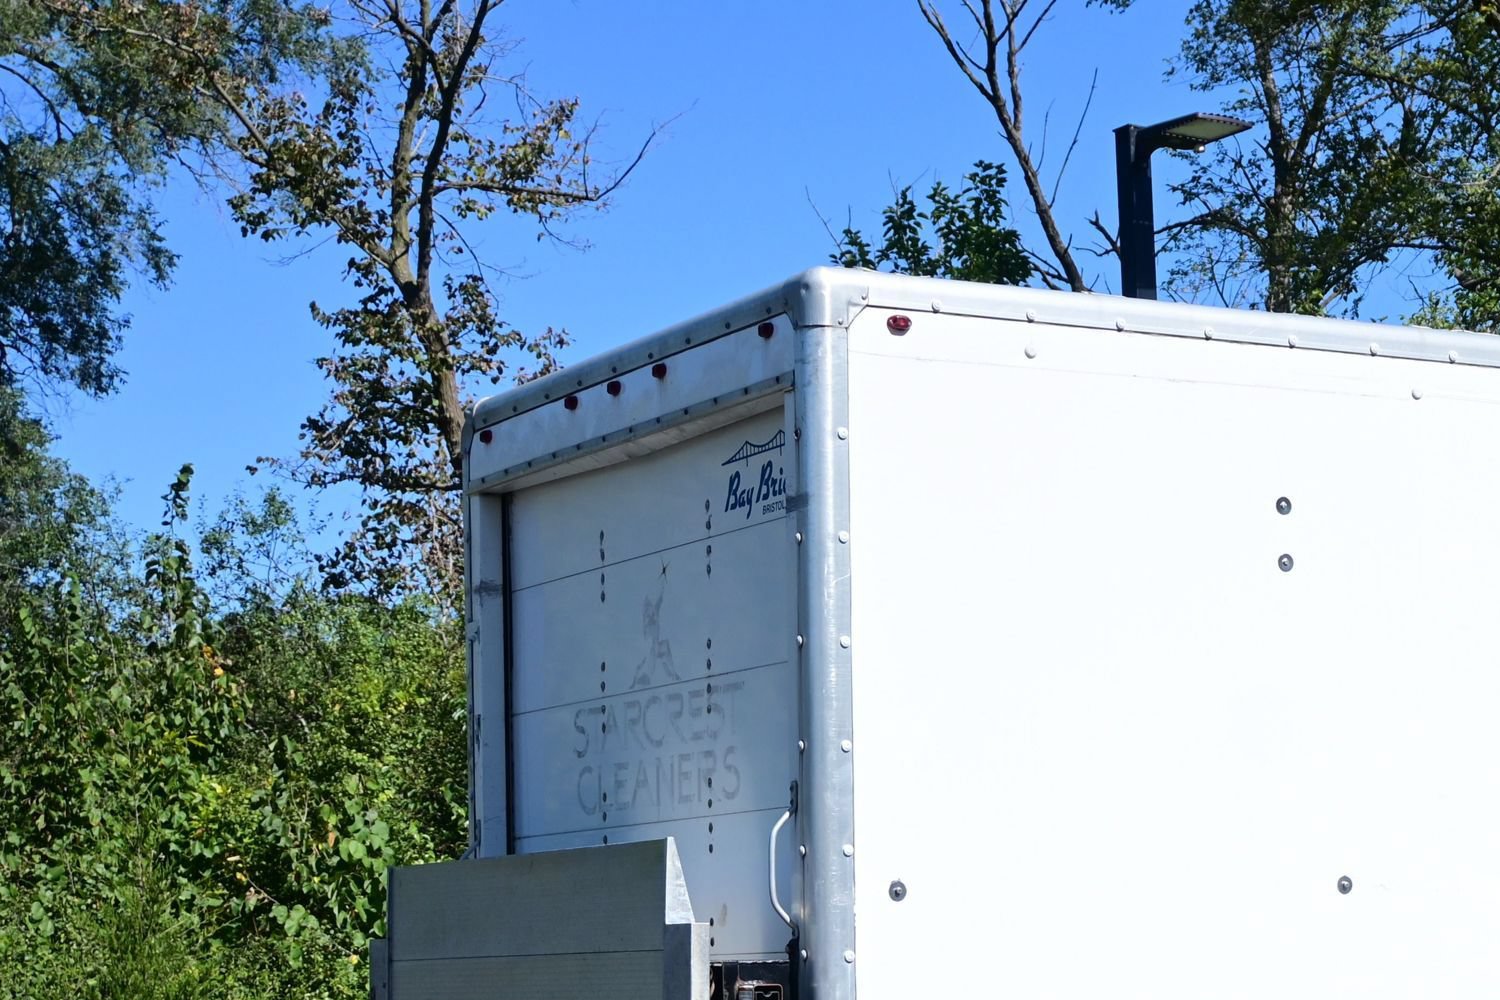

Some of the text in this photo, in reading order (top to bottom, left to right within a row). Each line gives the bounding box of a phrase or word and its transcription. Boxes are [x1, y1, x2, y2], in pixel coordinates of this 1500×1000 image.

[725, 471, 754, 519] Bay
[573, 681, 744, 759] STARCREST
[576, 746, 740, 816] CLEANERS
